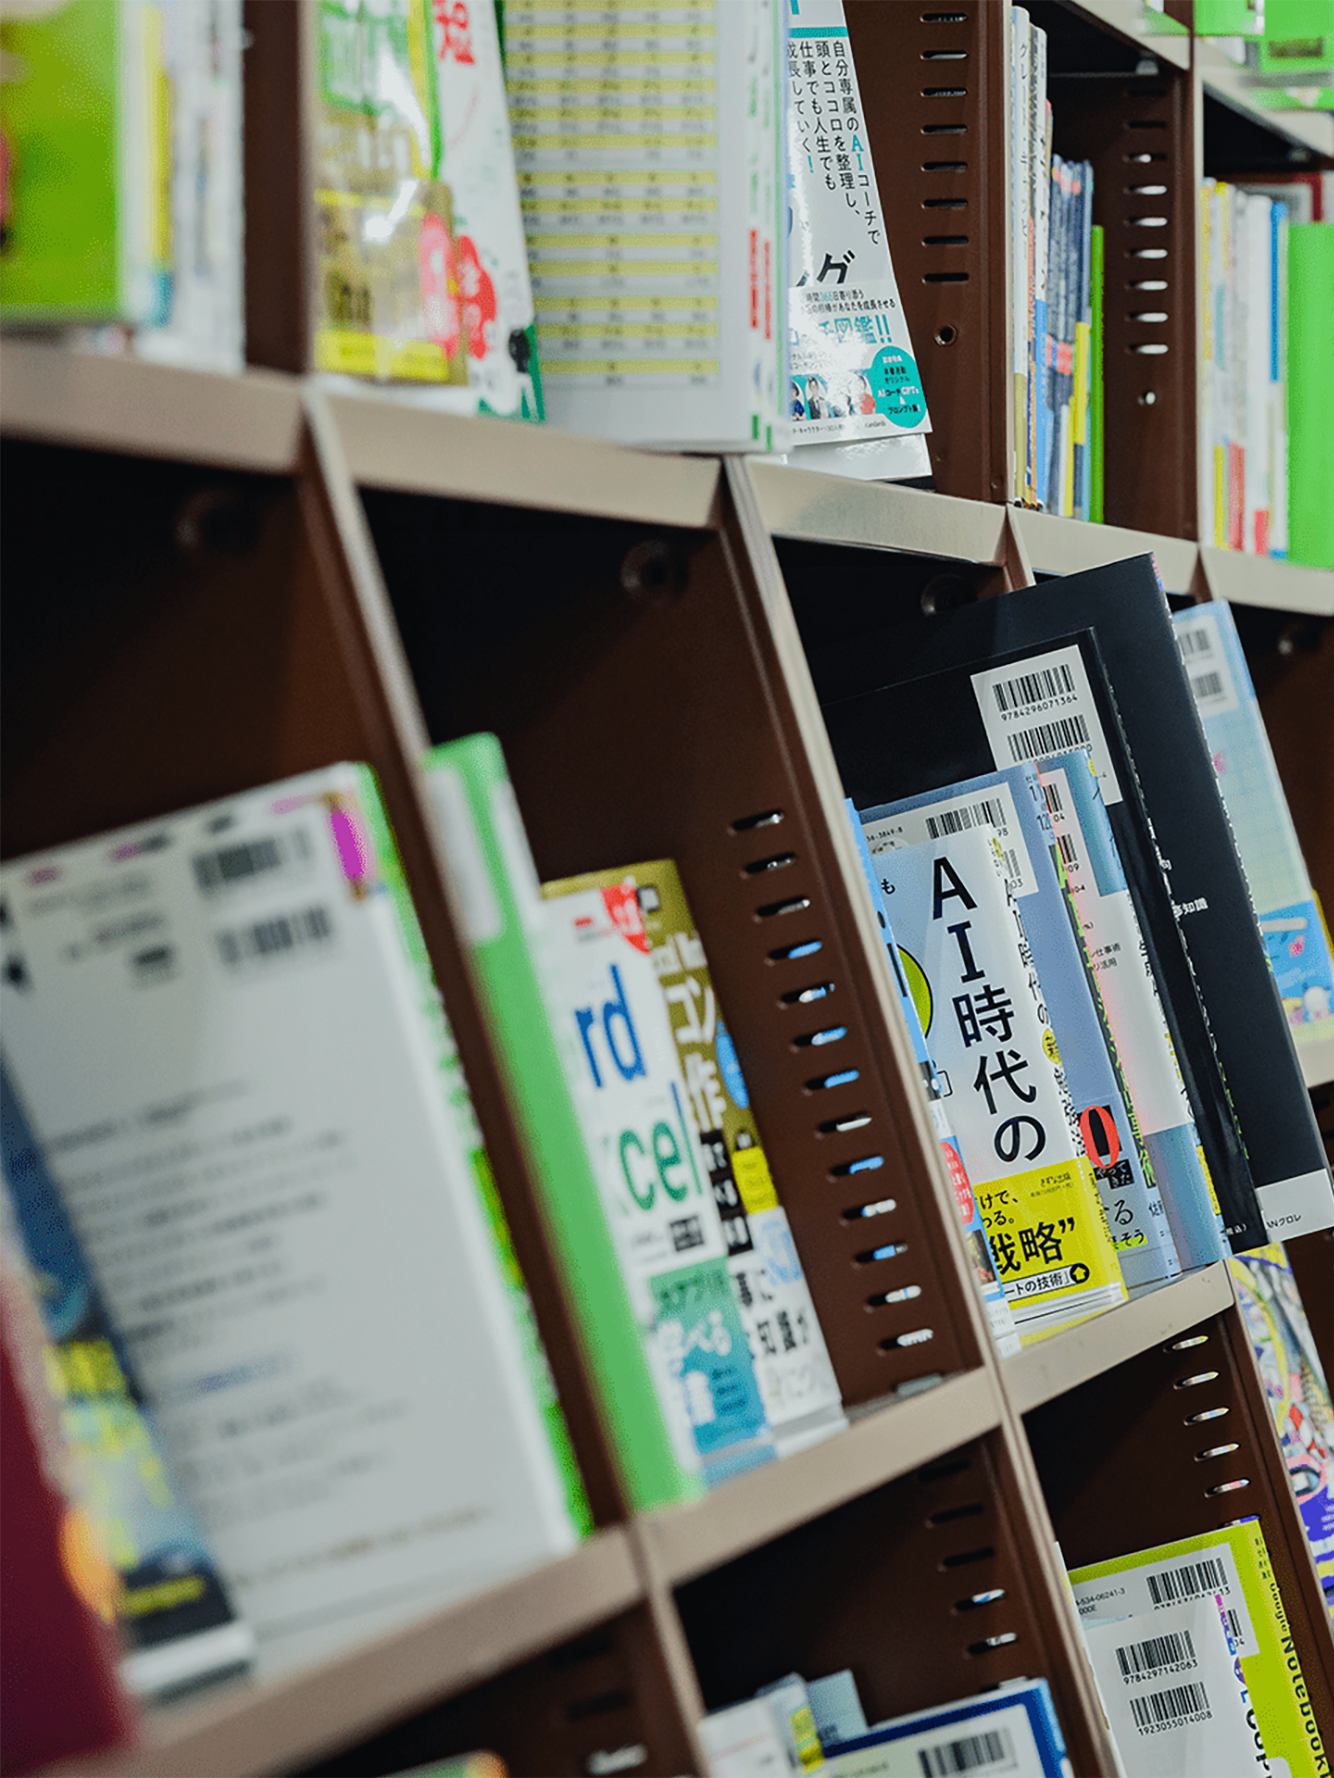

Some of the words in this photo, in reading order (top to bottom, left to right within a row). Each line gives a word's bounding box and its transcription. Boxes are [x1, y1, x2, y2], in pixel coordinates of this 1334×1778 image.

[800, 41, 836, 190] 仕事でも人生でも
[815, 40, 861, 215] 頭とココロを整理し、
[833, 41, 881, 245] 自分専属のAIコーチで
[1001, 695, 1079, 722] 9784296071364
[933, 856, 1046, 1162] AI時代の
[975, 1190, 1018, 1211] けで、
[1123, 1659, 1199, 1686] 9784297142063
[1138, 1711, 1213, 1736] 1923055014008
